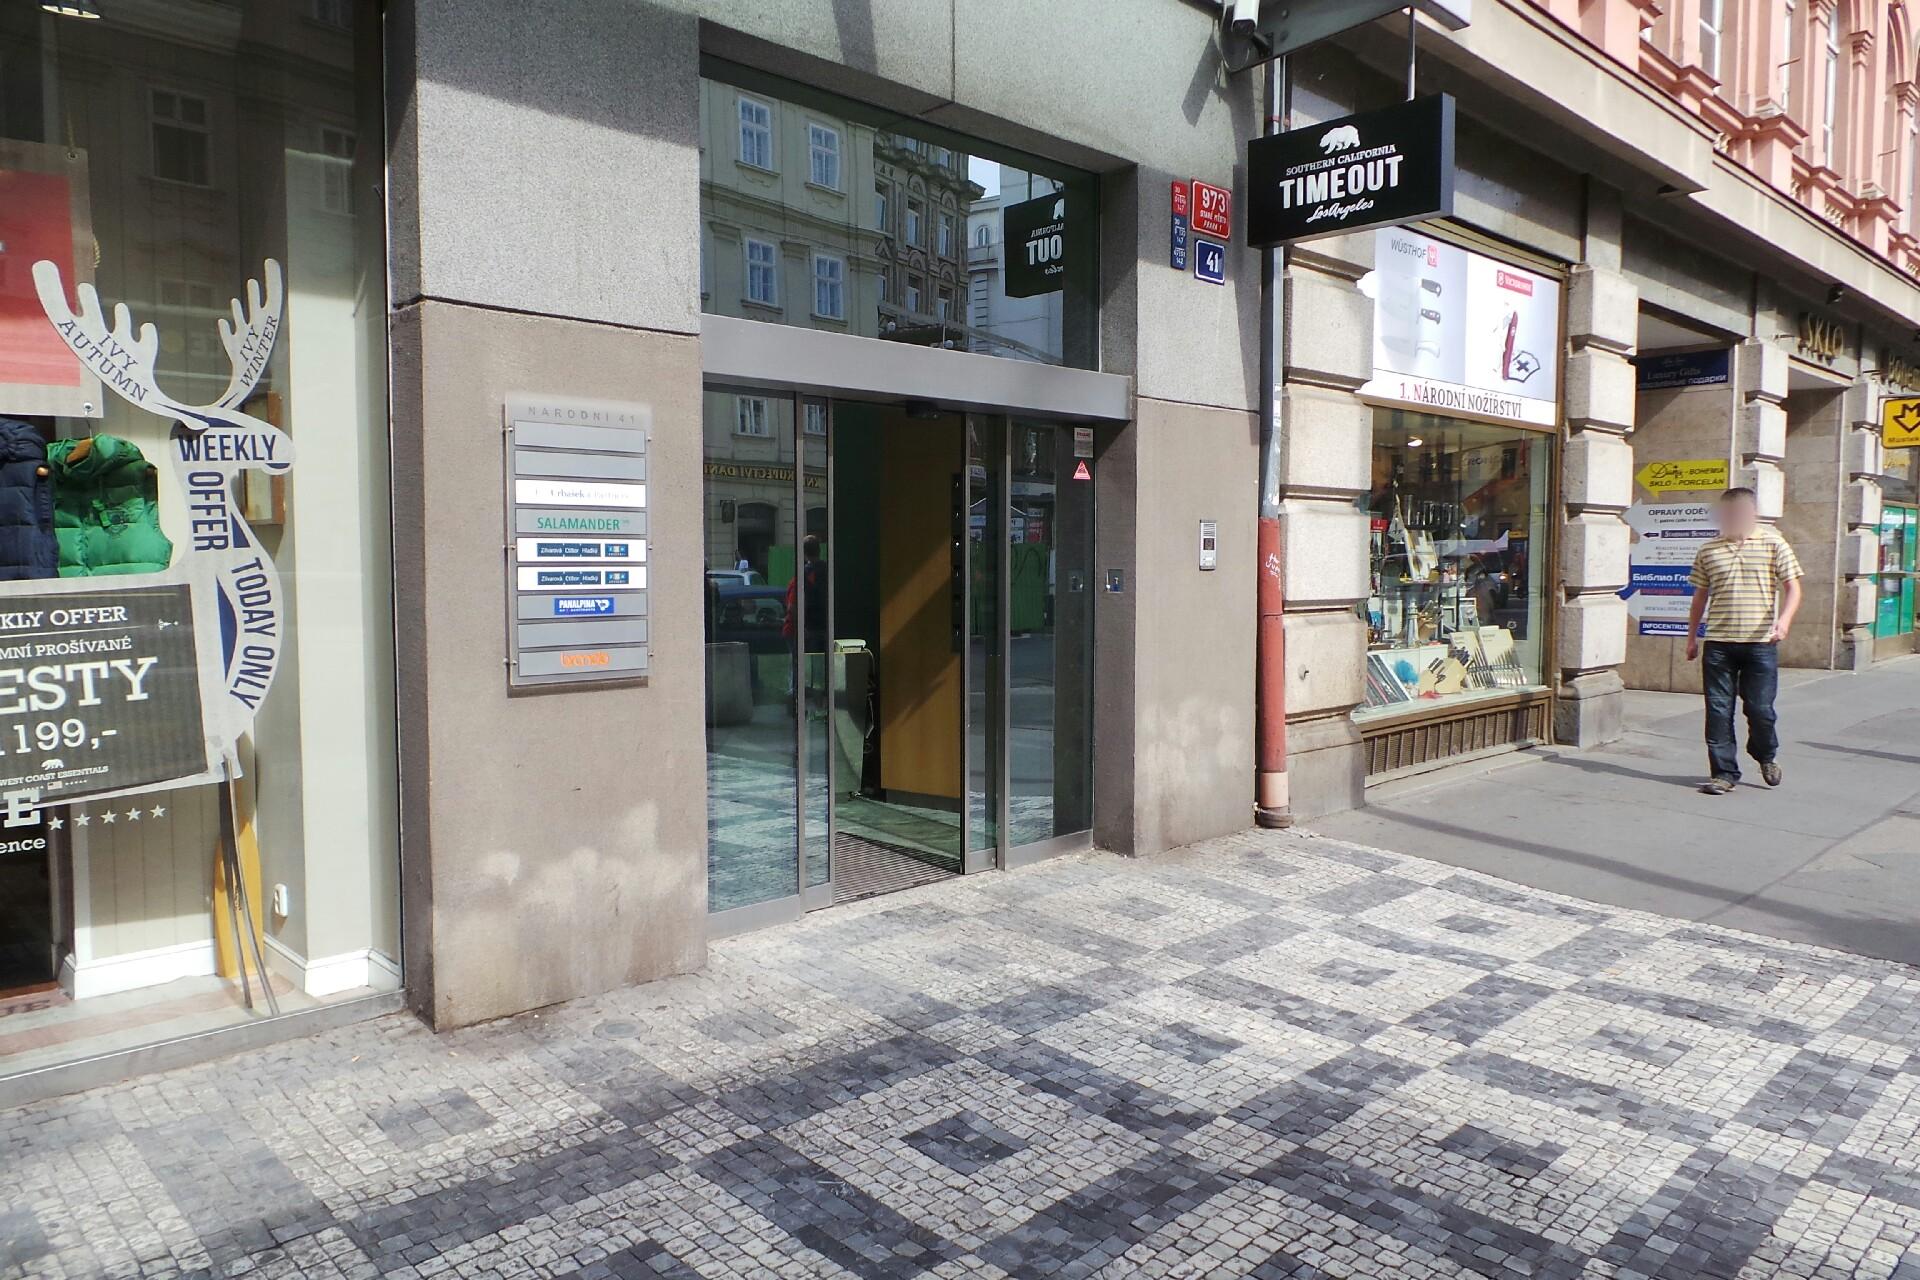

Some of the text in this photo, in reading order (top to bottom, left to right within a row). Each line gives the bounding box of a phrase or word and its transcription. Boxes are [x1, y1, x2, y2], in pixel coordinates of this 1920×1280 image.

[1286, 144, 1397, 176] SOUTHERN CALIFORNIA
[1279, 154, 1404, 209] TIMEOUT
[1202, 188, 1226, 213] 973
[1206, 250, 1220, 273] 41
[240, 325, 260, 362] IVY
[1807, 312, 1844, 358] SKLO
[57, 319, 149, 402] AUTUMN
[98, 334, 139, 372] IVY
[240, 315, 278, 388] WINTER
[1413, 381, 1466, 409] NÁRODNÍ
[178, 434, 277, 462] WEEKLY
[187, 470, 228, 552] OFFER
[537, 517, 620, 531] SALAMANDER
[1648, 508, 1683, 516] OPRAVY
[1632, 573, 1673, 581] Библио
[231, 556, 277, 638] TODAY
[558, 599, 596, 609] PANALPINA
[50, 605, 128, 626] OFFER
[35, 635, 132, 657] PROŠÍVANÉ
[229, 645, 276, 710] ONLY
[25, 772, 56, 783] COAST
[57, 765, 109, 779] ESSENTIALS
